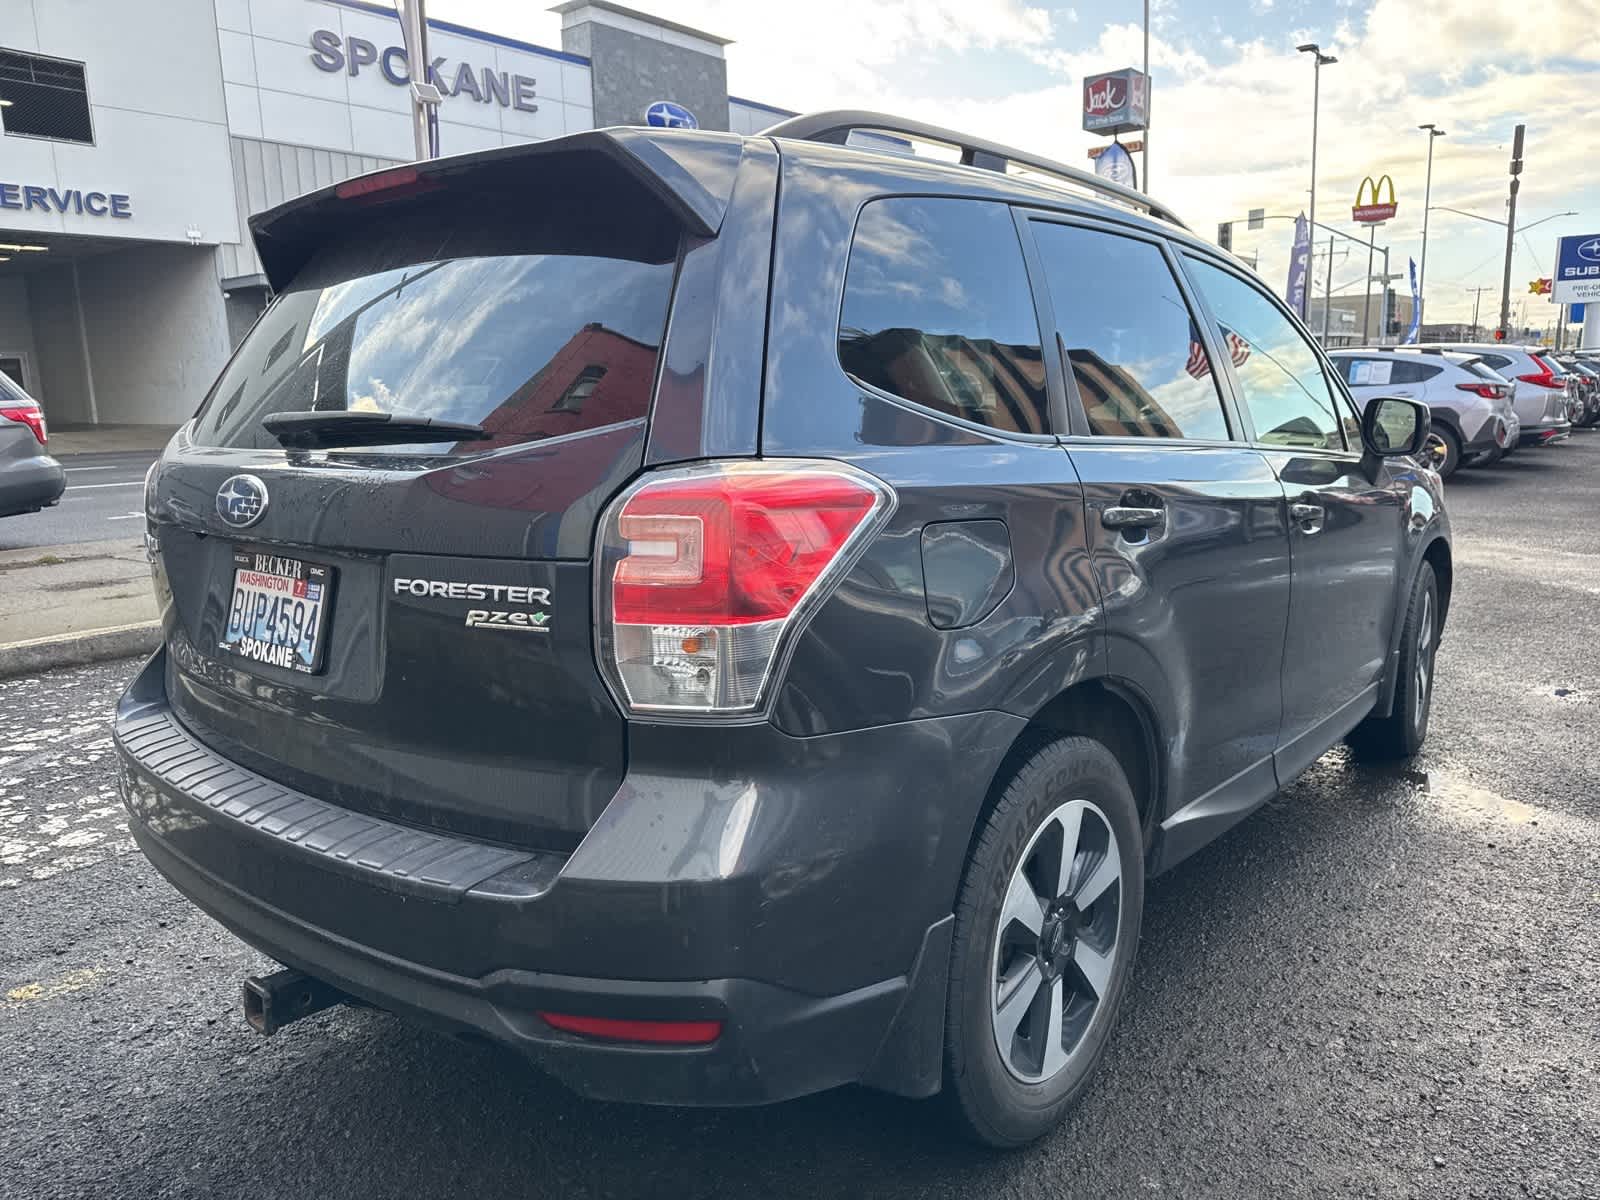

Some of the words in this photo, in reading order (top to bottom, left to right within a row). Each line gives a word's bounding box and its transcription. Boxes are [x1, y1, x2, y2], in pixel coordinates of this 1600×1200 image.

[311, 29, 538, 112] SPOKANE
[1087, 80, 1126, 112] Jack
[0, 183, 132, 218] ERVICE
[1564, 266, 1600, 277] SUB
[1572, 284, 1600, 292] PRE-O
[255, 553, 302, 579] BECKER
[239, 570, 289, 593] WASHINGTON
[296, 581, 303, 593] 7
[394, 578, 551, 605] FORESTER
[230, 588, 318, 653] BUP4594
[240, 636, 294, 669] SPOKANE
